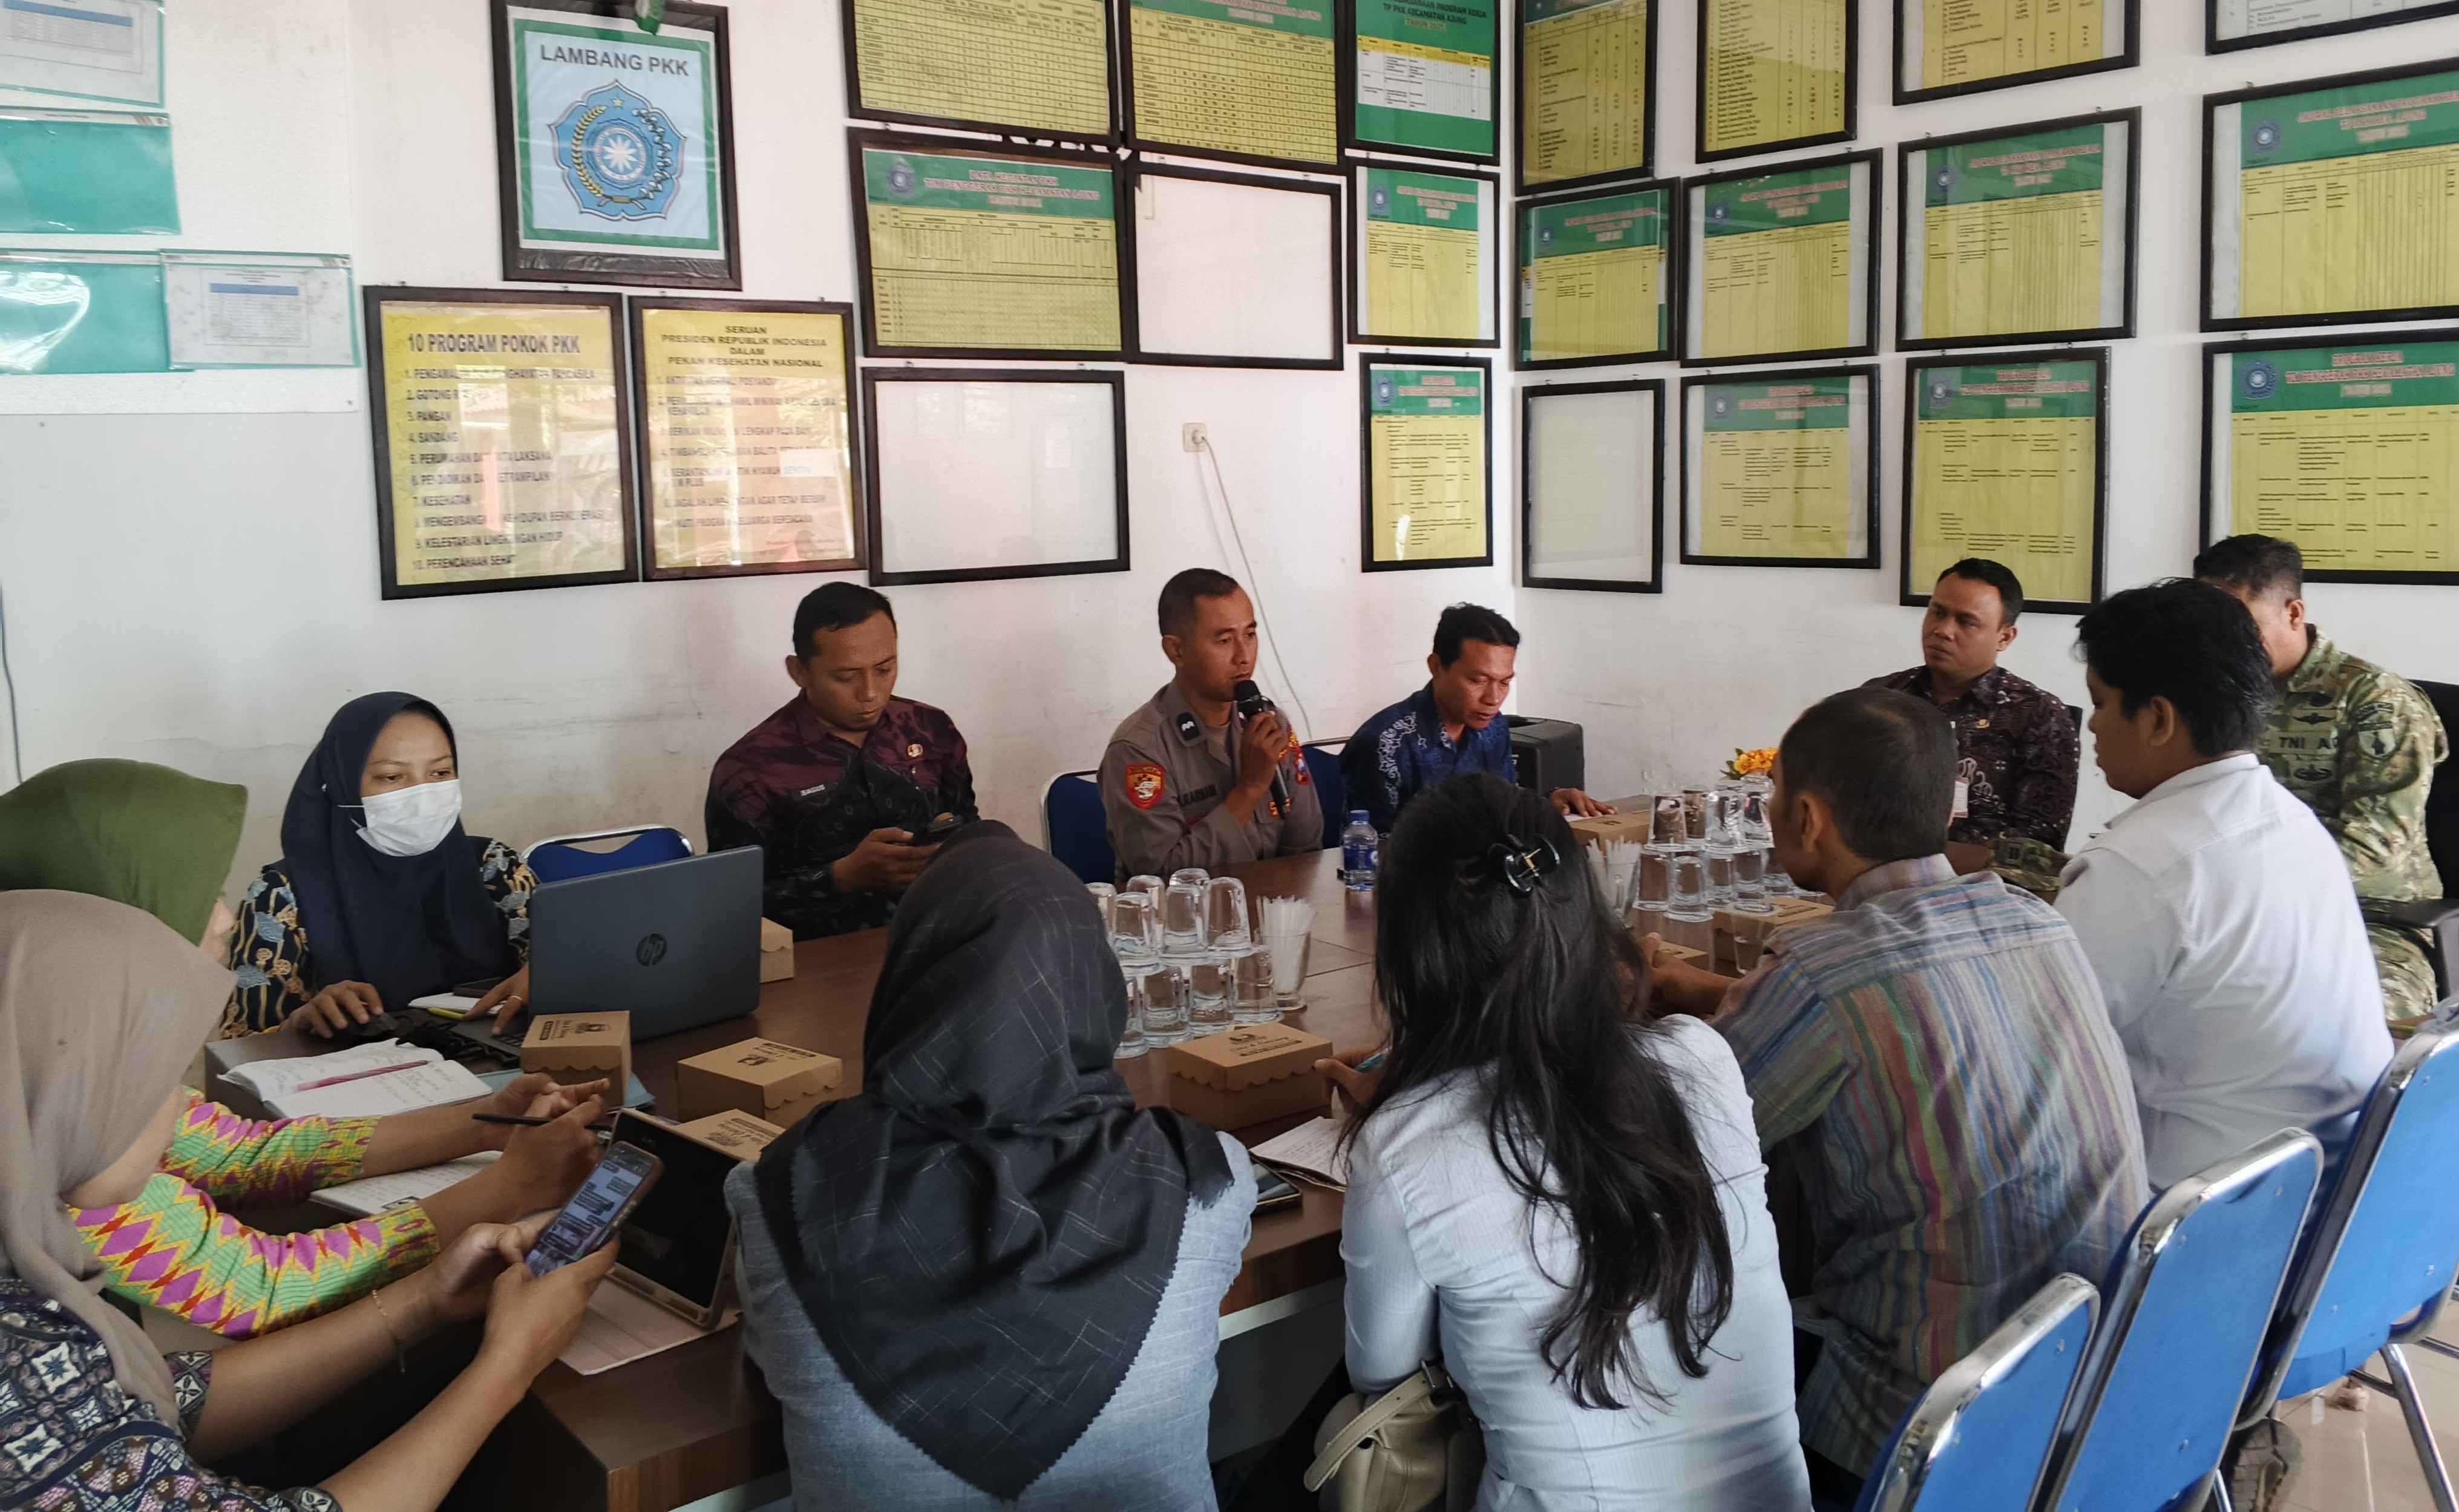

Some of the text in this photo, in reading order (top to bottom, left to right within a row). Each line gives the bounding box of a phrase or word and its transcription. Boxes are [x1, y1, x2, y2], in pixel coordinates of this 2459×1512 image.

[540, 44, 689, 76] LAMBANG PKK
[725, 326, 767, 334] SERUAN
[408, 333, 581, 353] 10 PROGRAM POKOK PKK
[661, 334, 827, 347] PRESIDEN REPUBLIK INDONESIA
[729, 347, 765, 355] DALAM
[668, 356, 823, 368] PEKAN KESEHATAN NASIONAL
[416, 411, 451, 422] PANGAN
[419, 432, 459, 442] SANDANG
[2279, 736, 2305, 749] TNI
[637, 933, 667, 967] hp
